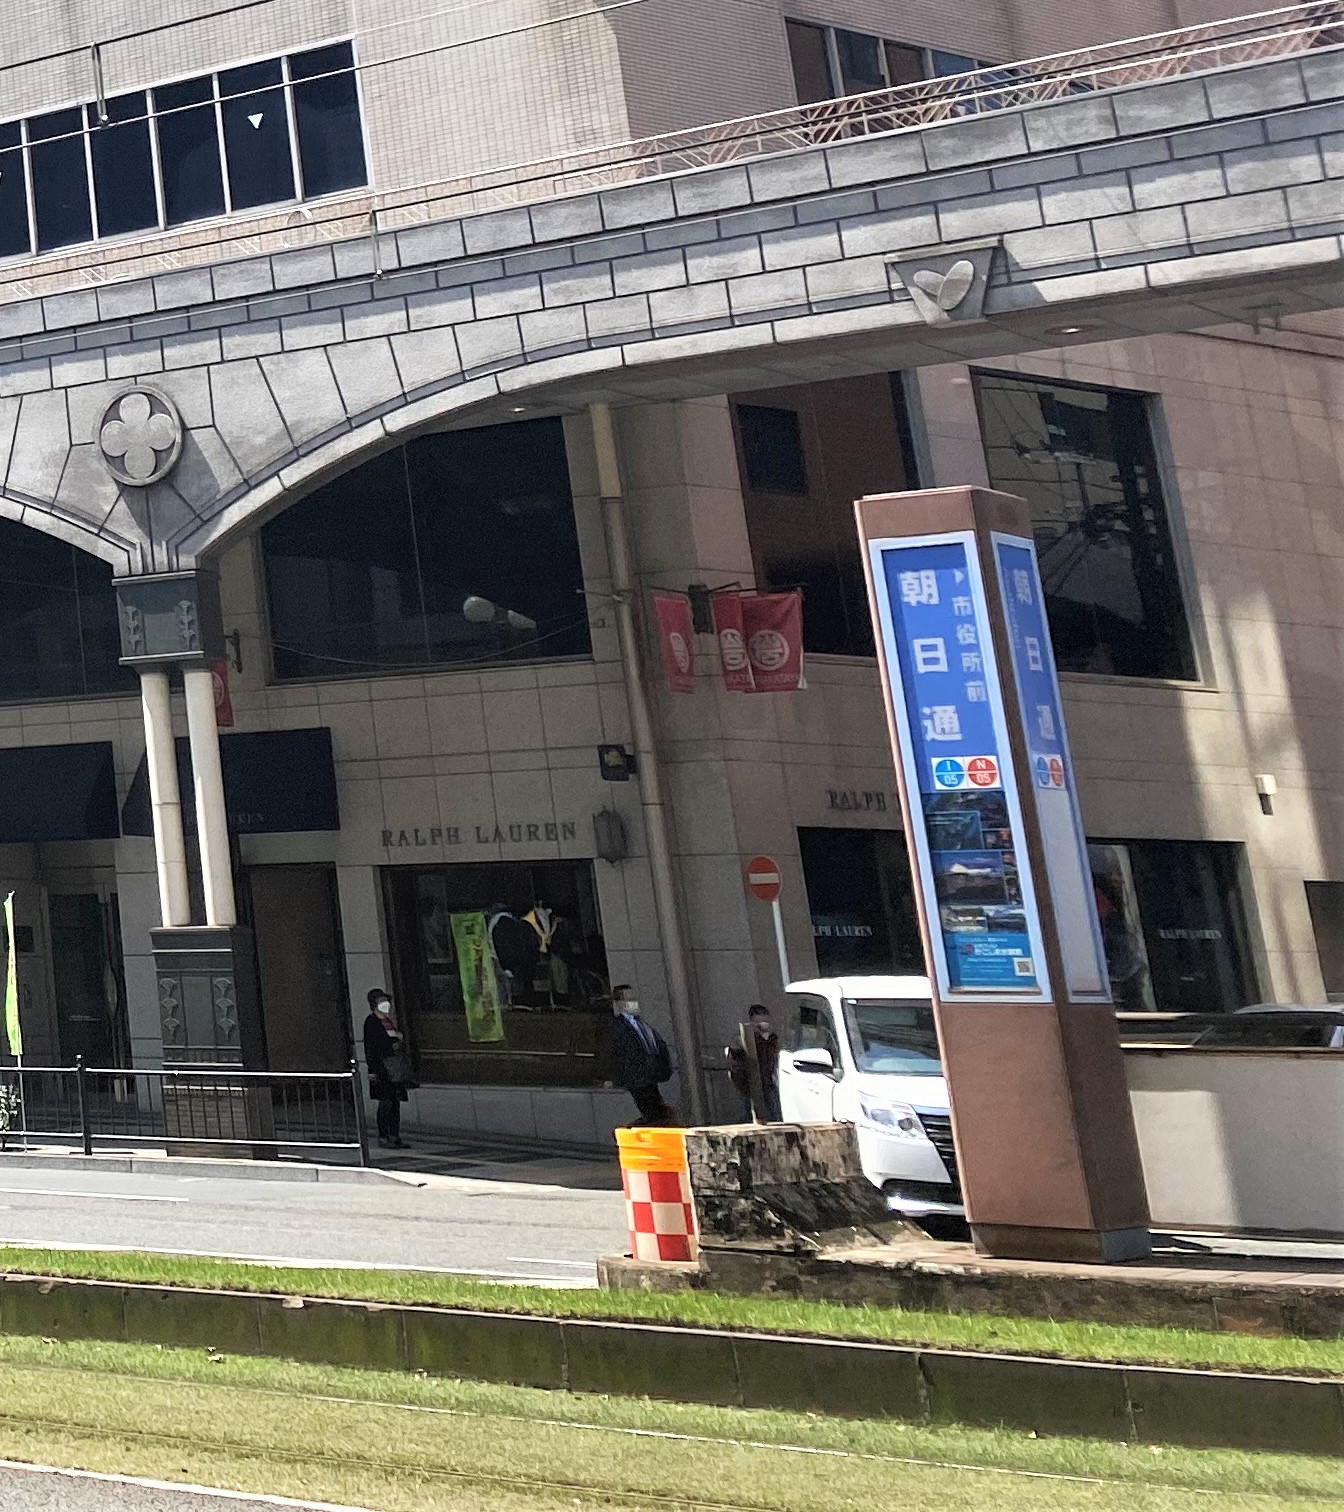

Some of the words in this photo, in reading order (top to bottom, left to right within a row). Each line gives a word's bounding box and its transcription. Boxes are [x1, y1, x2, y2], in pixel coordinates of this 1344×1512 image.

[898, 569, 963, 741] 朝日通
[952, 595, 987, 703] 市役所前
[1013, 569, 1056, 740] 朝日通
[943, 774, 958, 785] 05
[976, 773, 991, 784] 05
[825, 791, 887, 811] RALPH
[381, 828, 462, 848] RALPH
[475, 821, 577, 844] LAUREN
